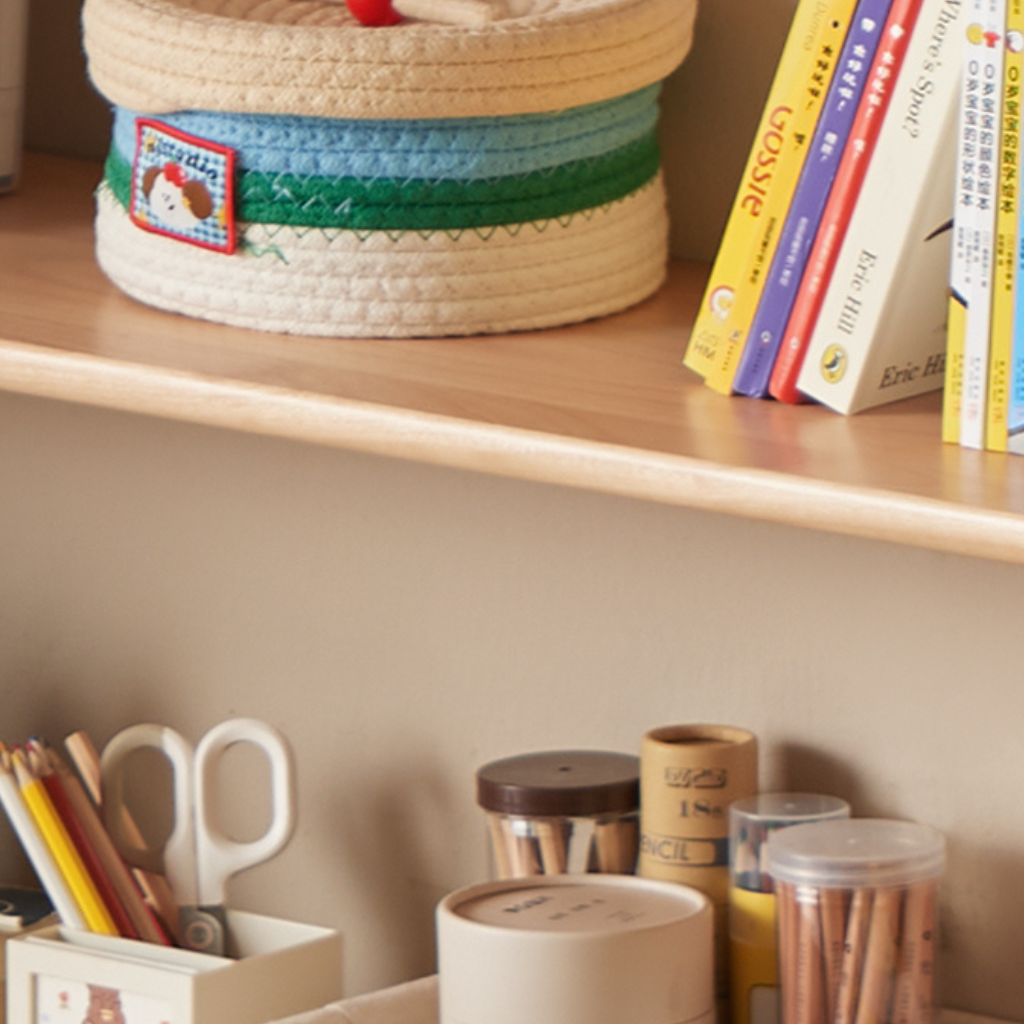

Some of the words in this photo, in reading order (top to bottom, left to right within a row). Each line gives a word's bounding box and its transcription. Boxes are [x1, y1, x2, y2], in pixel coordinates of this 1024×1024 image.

[902, 75, 935, 140] Spot?
[851, 248, 878, 292] Eric
[837, 295, 863, 336] Hill
[878, 361, 920, 390] Eric
